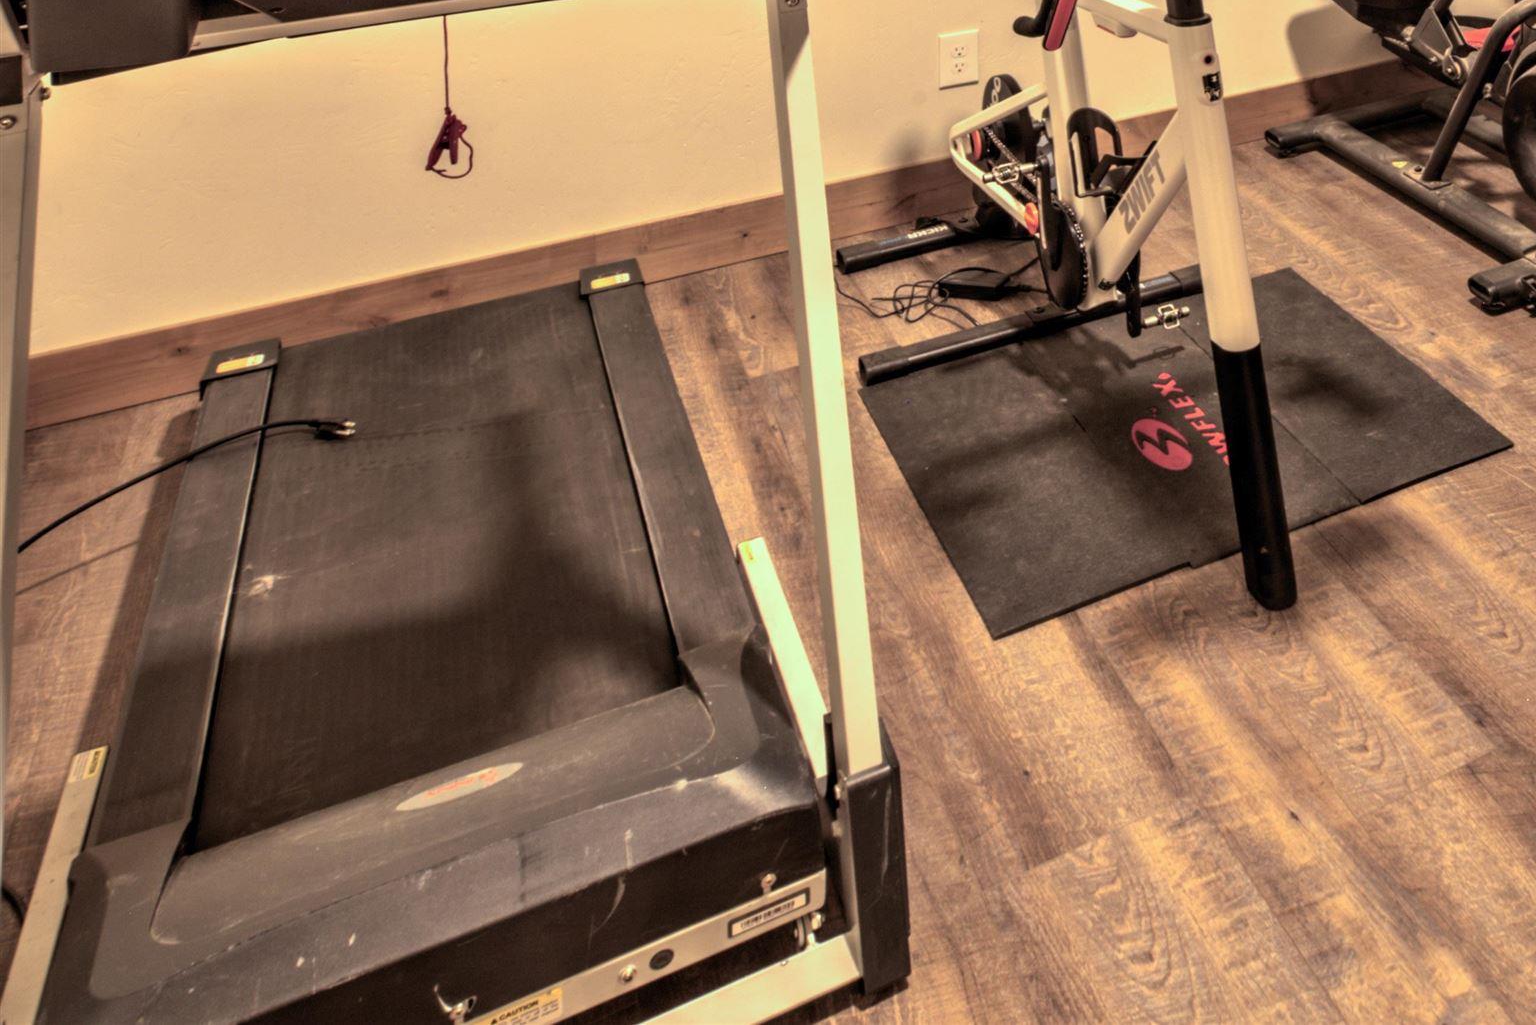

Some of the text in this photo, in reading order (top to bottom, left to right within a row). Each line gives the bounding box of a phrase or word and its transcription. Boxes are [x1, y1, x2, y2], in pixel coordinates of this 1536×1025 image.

[1118, 149, 1166, 234] ZWIFT
[1152, 376, 1230, 466] WFLEX
[498, 999, 540, 1021] CAUTION
